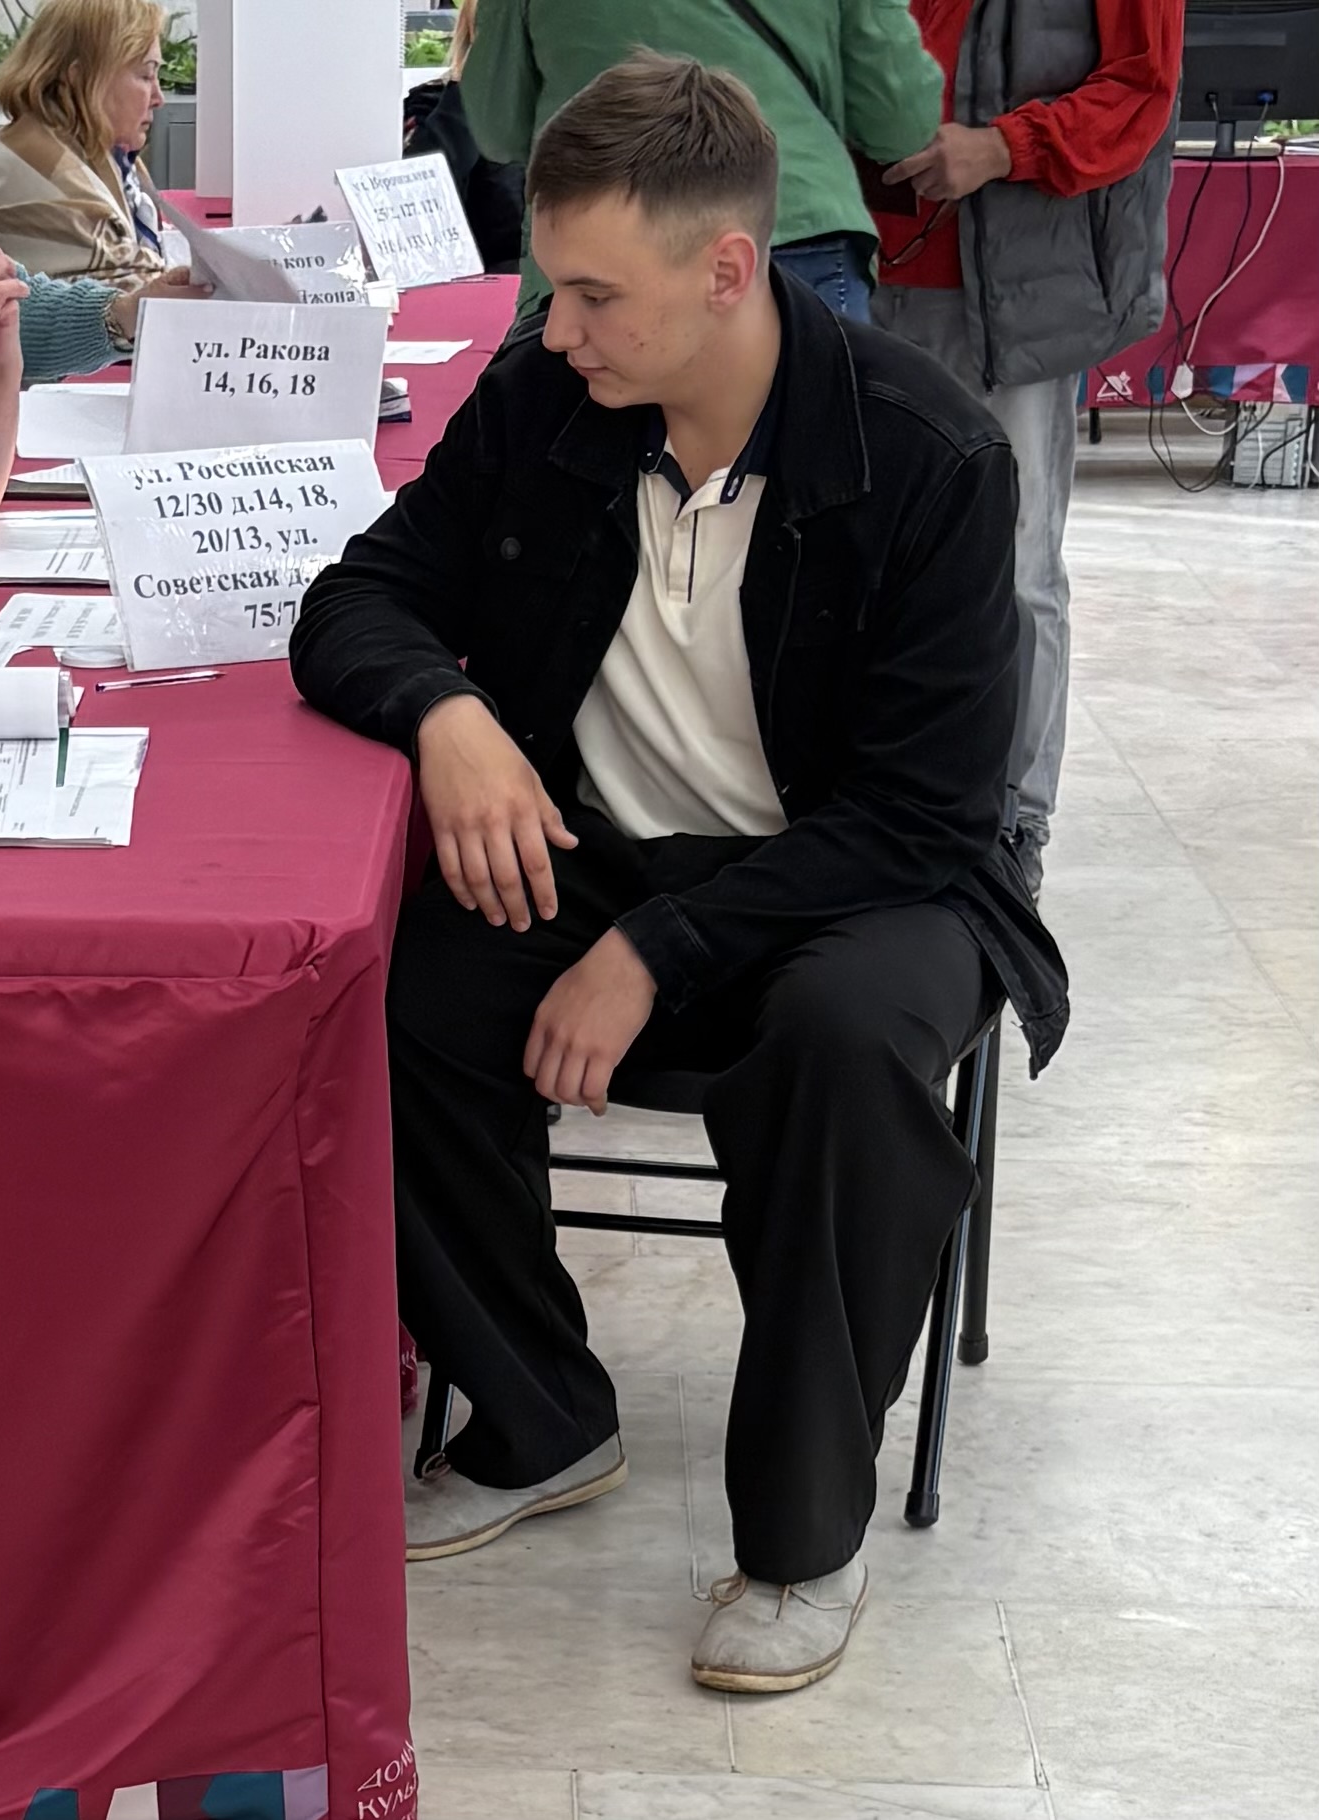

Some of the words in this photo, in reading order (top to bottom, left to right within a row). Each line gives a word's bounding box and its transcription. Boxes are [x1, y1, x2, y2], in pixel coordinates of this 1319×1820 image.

[192, 342, 230, 363] ул.
[239, 337, 330, 361] Ракова
[203, 371, 235, 398] 14,
[246, 372, 278, 399] 16,
[289, 374, 316, 396] 18
[128, 469, 172, 490] ул.
[176, 455, 336, 481] Российская
[154, 492, 223, 519] 12/30
[231, 487, 293, 515] д.14,
[297, 484, 338, 510] 18,
[192, 525, 272, 554] 20/13,
[277, 528, 318, 553] ул.
[134, 569, 280, 599] Советская
